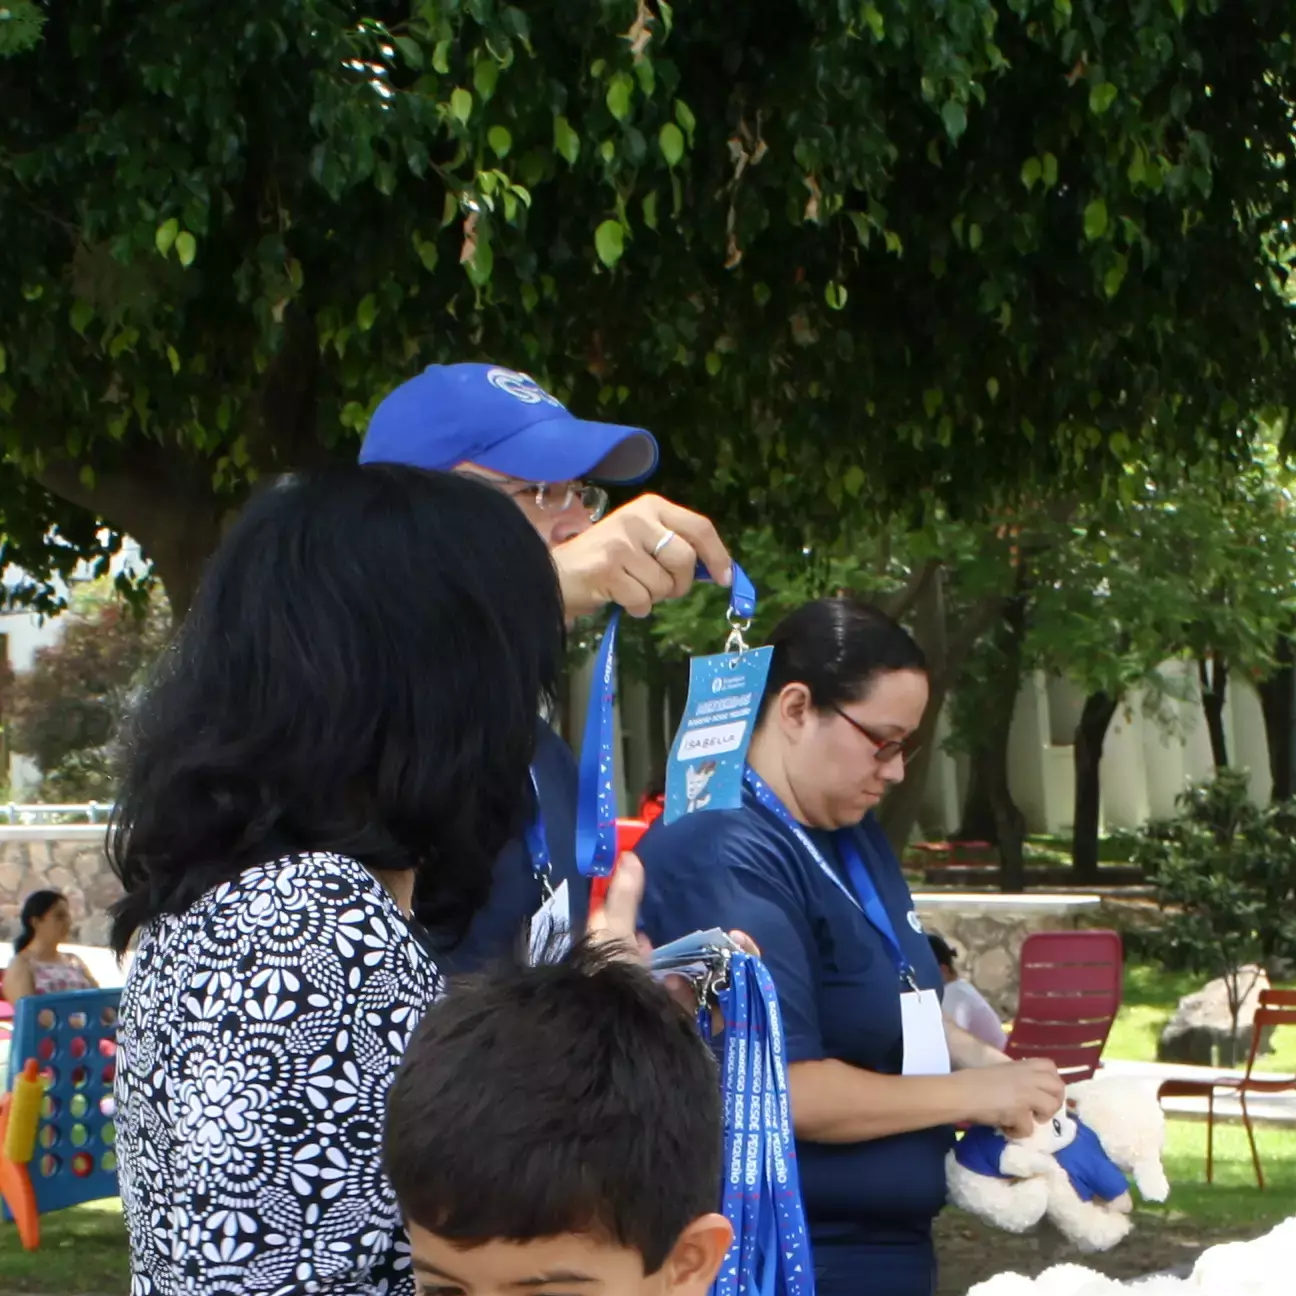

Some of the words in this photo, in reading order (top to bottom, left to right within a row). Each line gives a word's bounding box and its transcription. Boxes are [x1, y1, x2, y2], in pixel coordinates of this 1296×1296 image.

[734, 1094, 745, 1130] DESDE
[748, 1095, 761, 1131] DESDE
[730, 1132, 744, 1184] PEQUEÑO
[745, 1133, 760, 1185] PEQUEÑO
